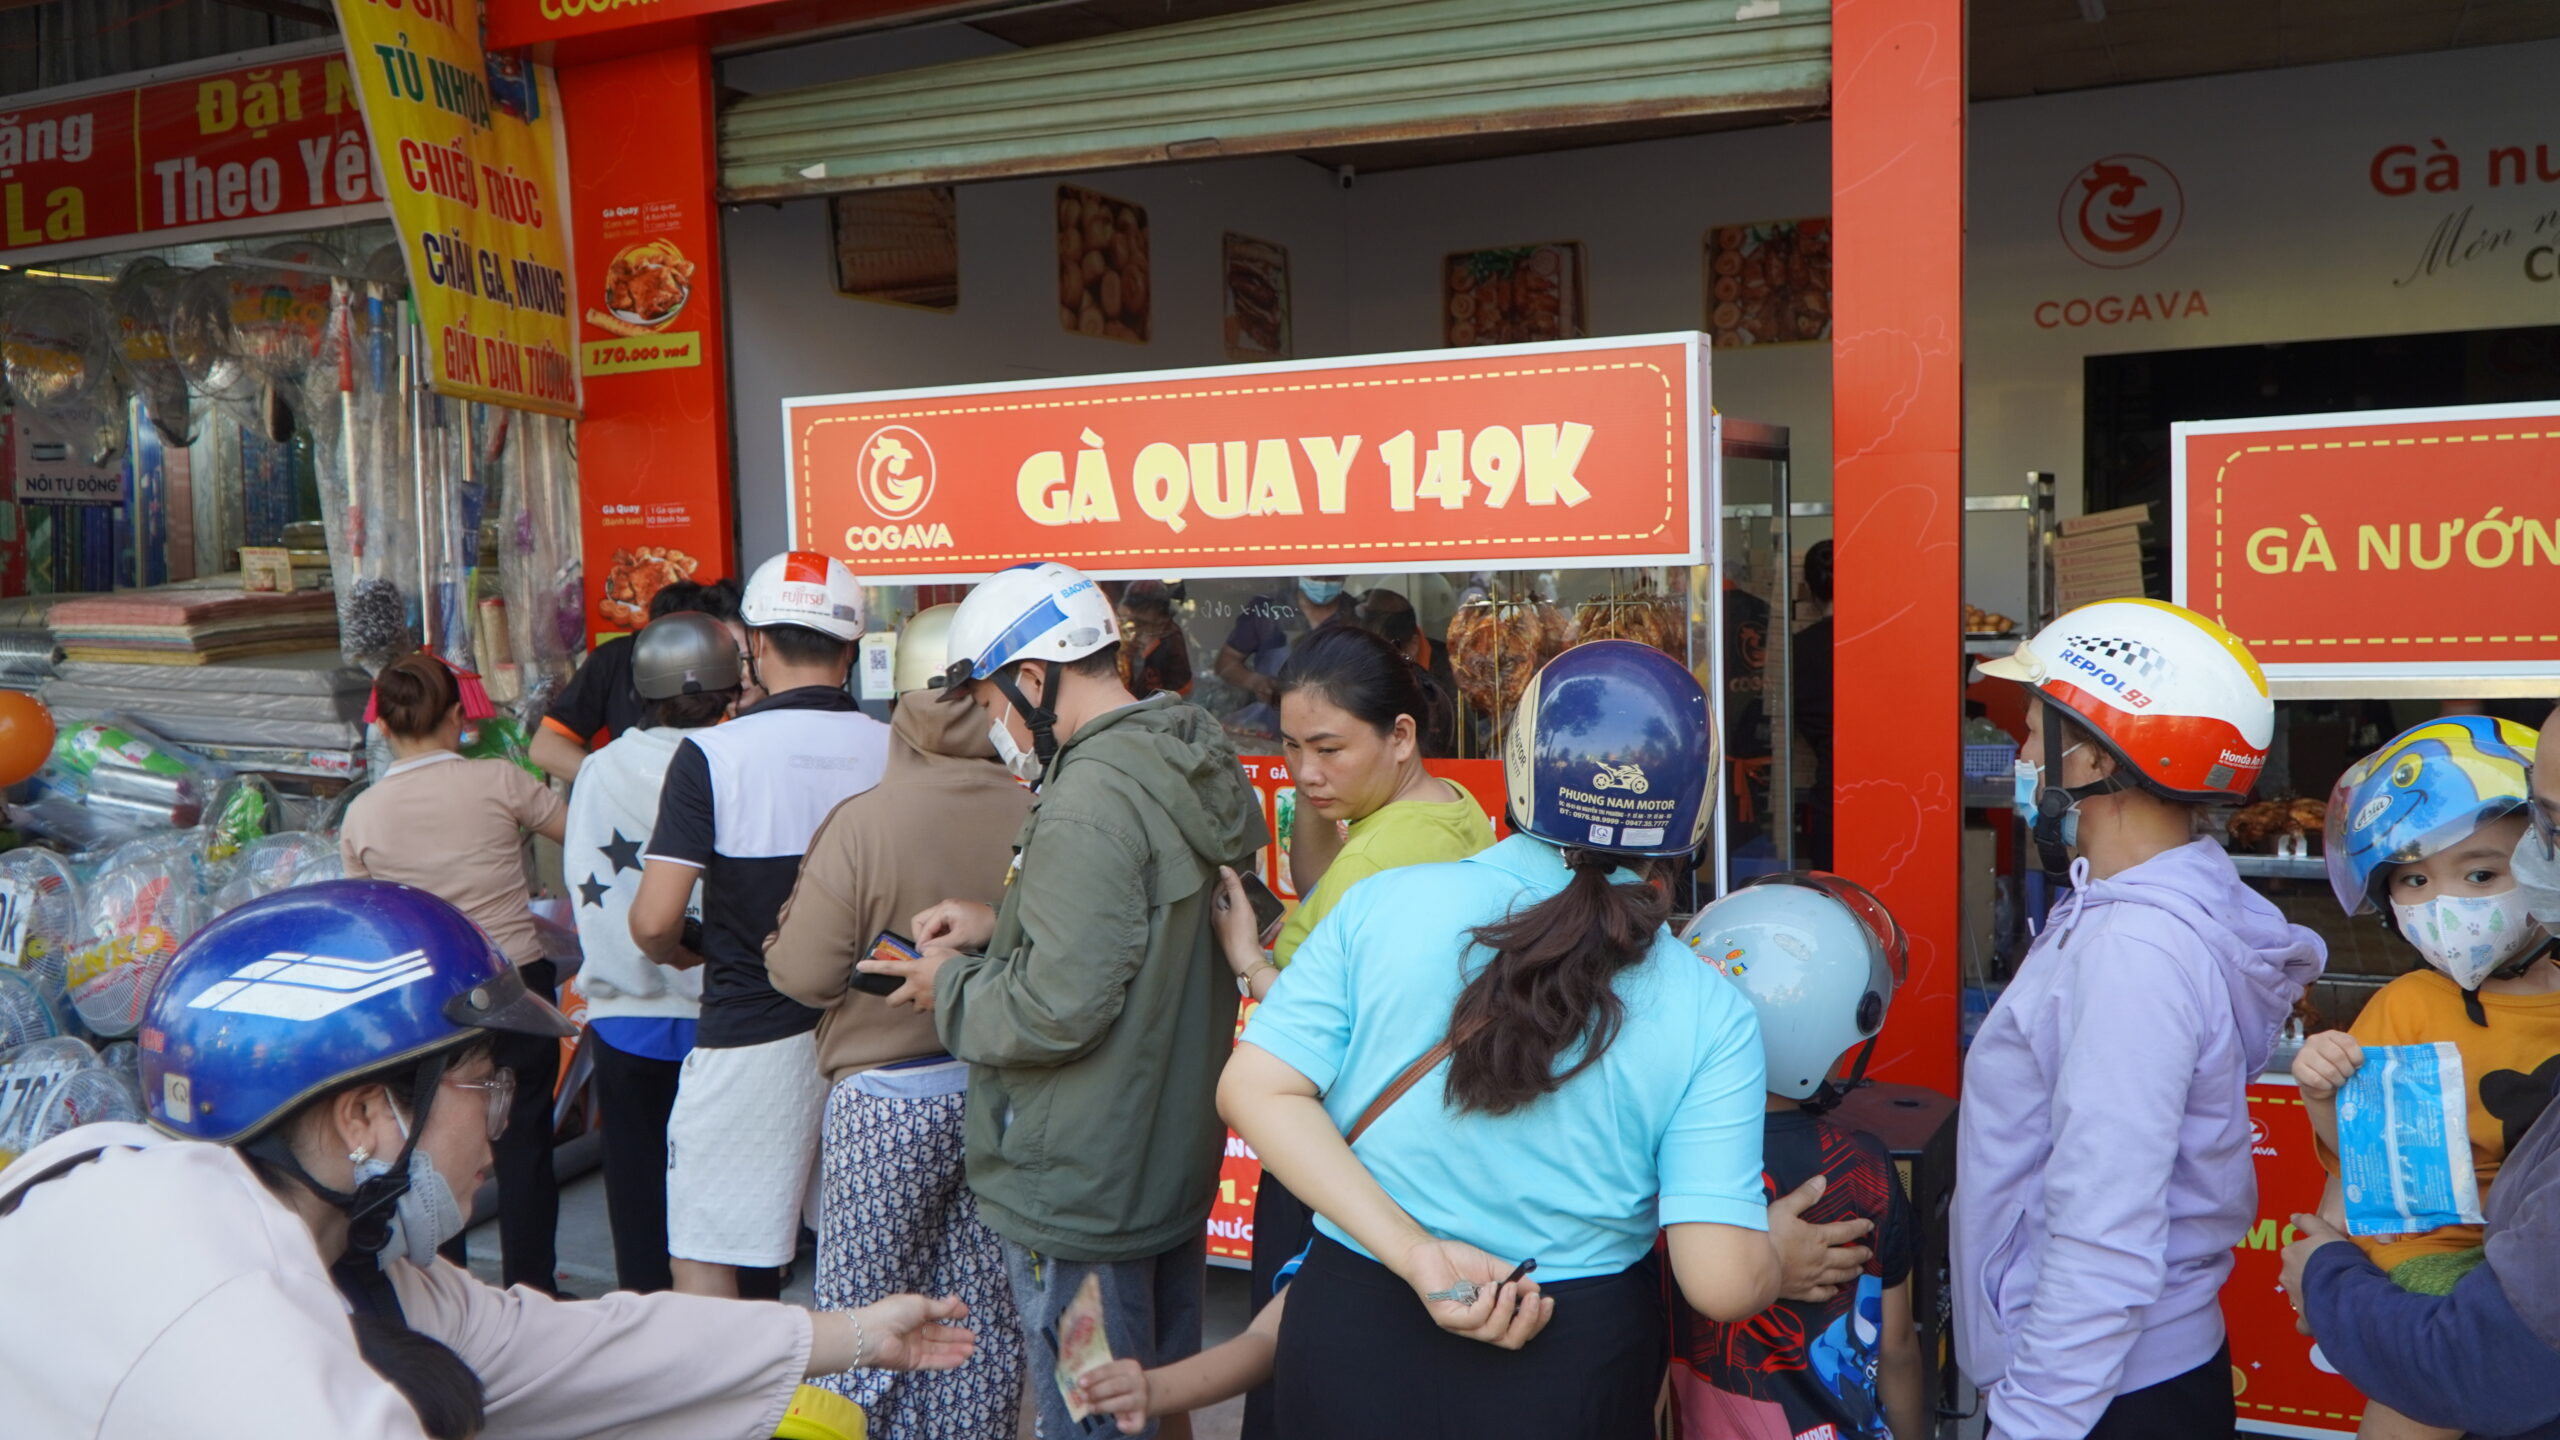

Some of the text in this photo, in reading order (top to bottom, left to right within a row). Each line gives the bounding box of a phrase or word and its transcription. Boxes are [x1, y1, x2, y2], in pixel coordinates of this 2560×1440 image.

[195, 69, 303, 139] Đặt
[374, 31, 424, 103] TỦ
[427, 56, 492, 134] NHỰA
[154, 155, 281, 226] Theo
[400, 137, 543, 230] CHIẾU TRÚC
[2369, 136, 2460, 196] Gà
[5, 183, 86, 248] La
[422, 228, 566, 318] CHĂN GA, MÙNG
[2034, 289, 2209, 328] COGAVA
[443, 313, 577, 405] GIẤY DÁN TƯỜNG
[592, 345, 660, 366] 170.000
[56, 476, 76, 497] TỰ
[77, 474, 118, 496] ĐỘNG
[1016, 421, 1595, 535] GÀ QUAY 149K
[616, 504, 641, 515] Quay
[845, 523, 954, 551] COGAVA
[2245, 513, 2338, 575] GÀ
[782, 589, 825, 606] FUJITSU
[2059, 648, 2153, 709] REPSOL 93
[1269, 764, 1289, 779] GÀ
[2219, 748, 2251, 765] Honda
[1559, 786, 1605, 806] PHUONG
[1606, 797, 1635, 810] NAM
[1636, 799, 1676, 811] MOTOR
